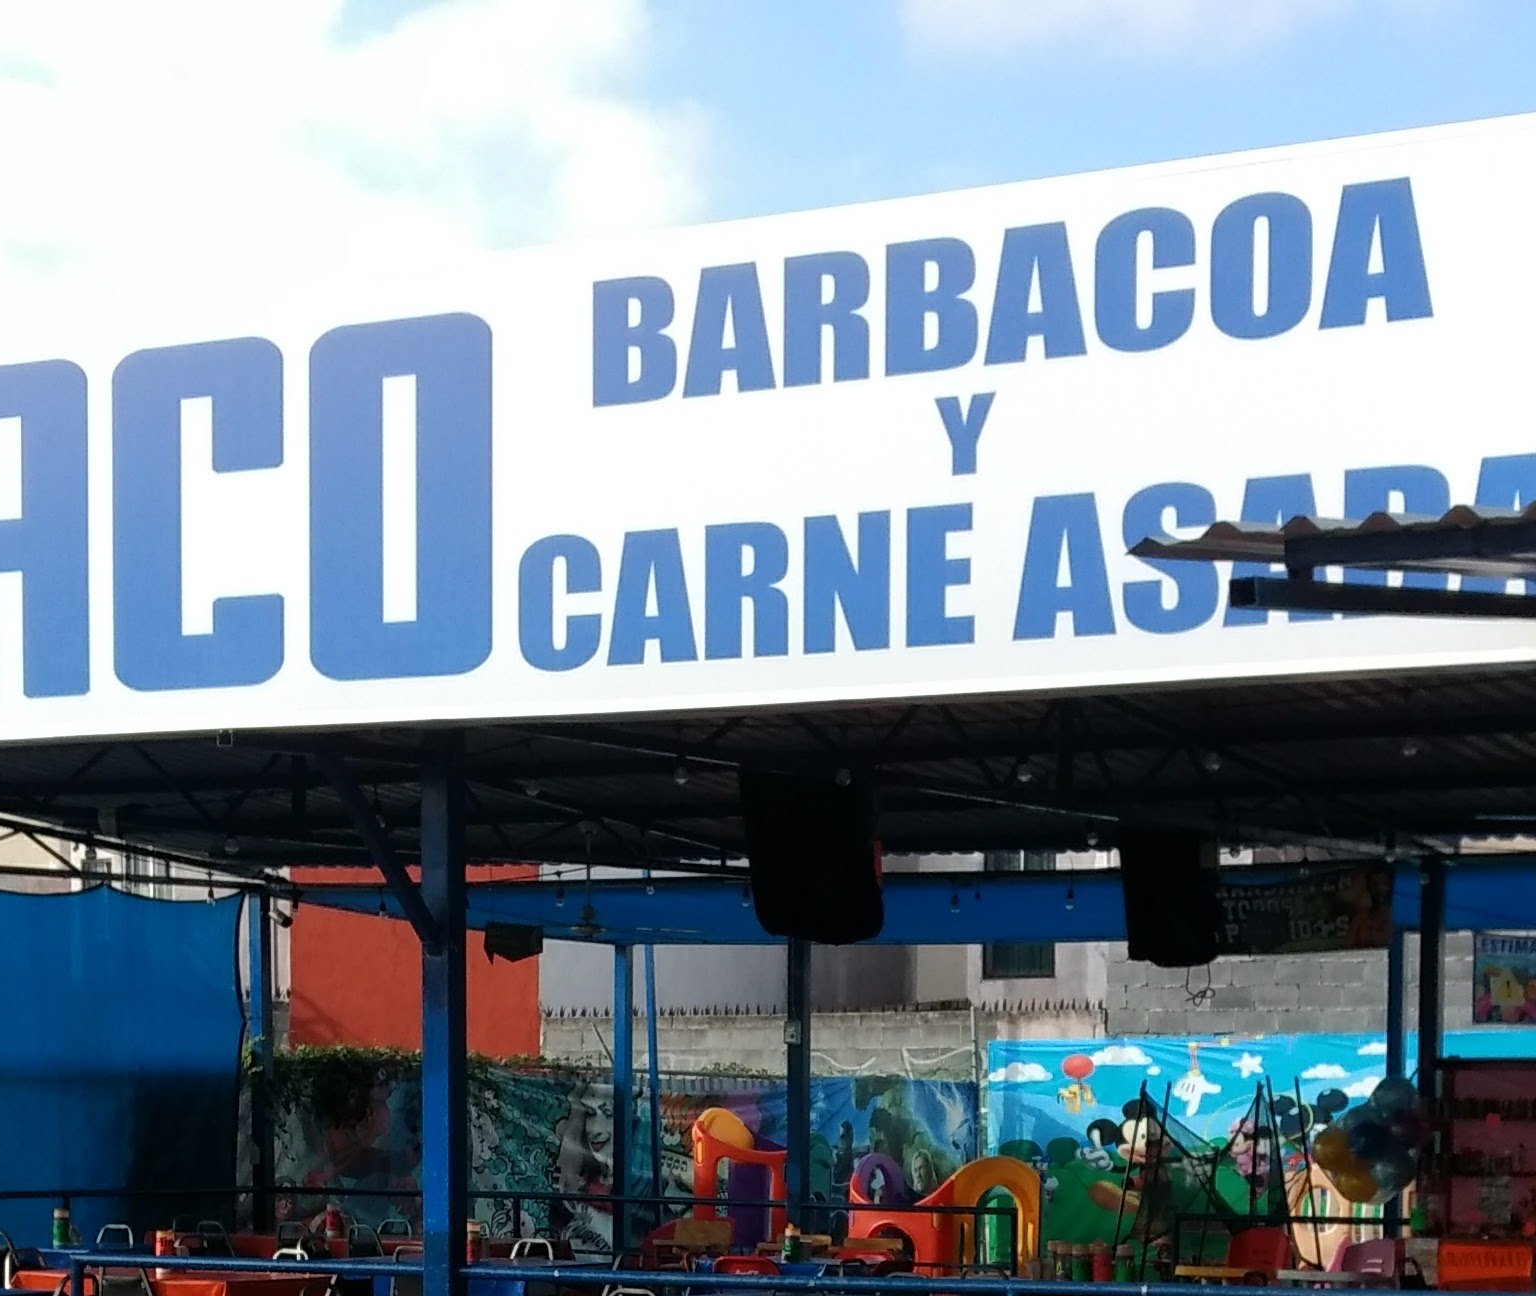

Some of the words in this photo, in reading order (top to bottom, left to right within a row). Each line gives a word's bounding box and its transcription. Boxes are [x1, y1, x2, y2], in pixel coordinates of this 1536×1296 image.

[592, 176, 1433, 407] BARBACOA
[934, 391, 996, 476] Y
[517, 502, 976, 672] CARNE
